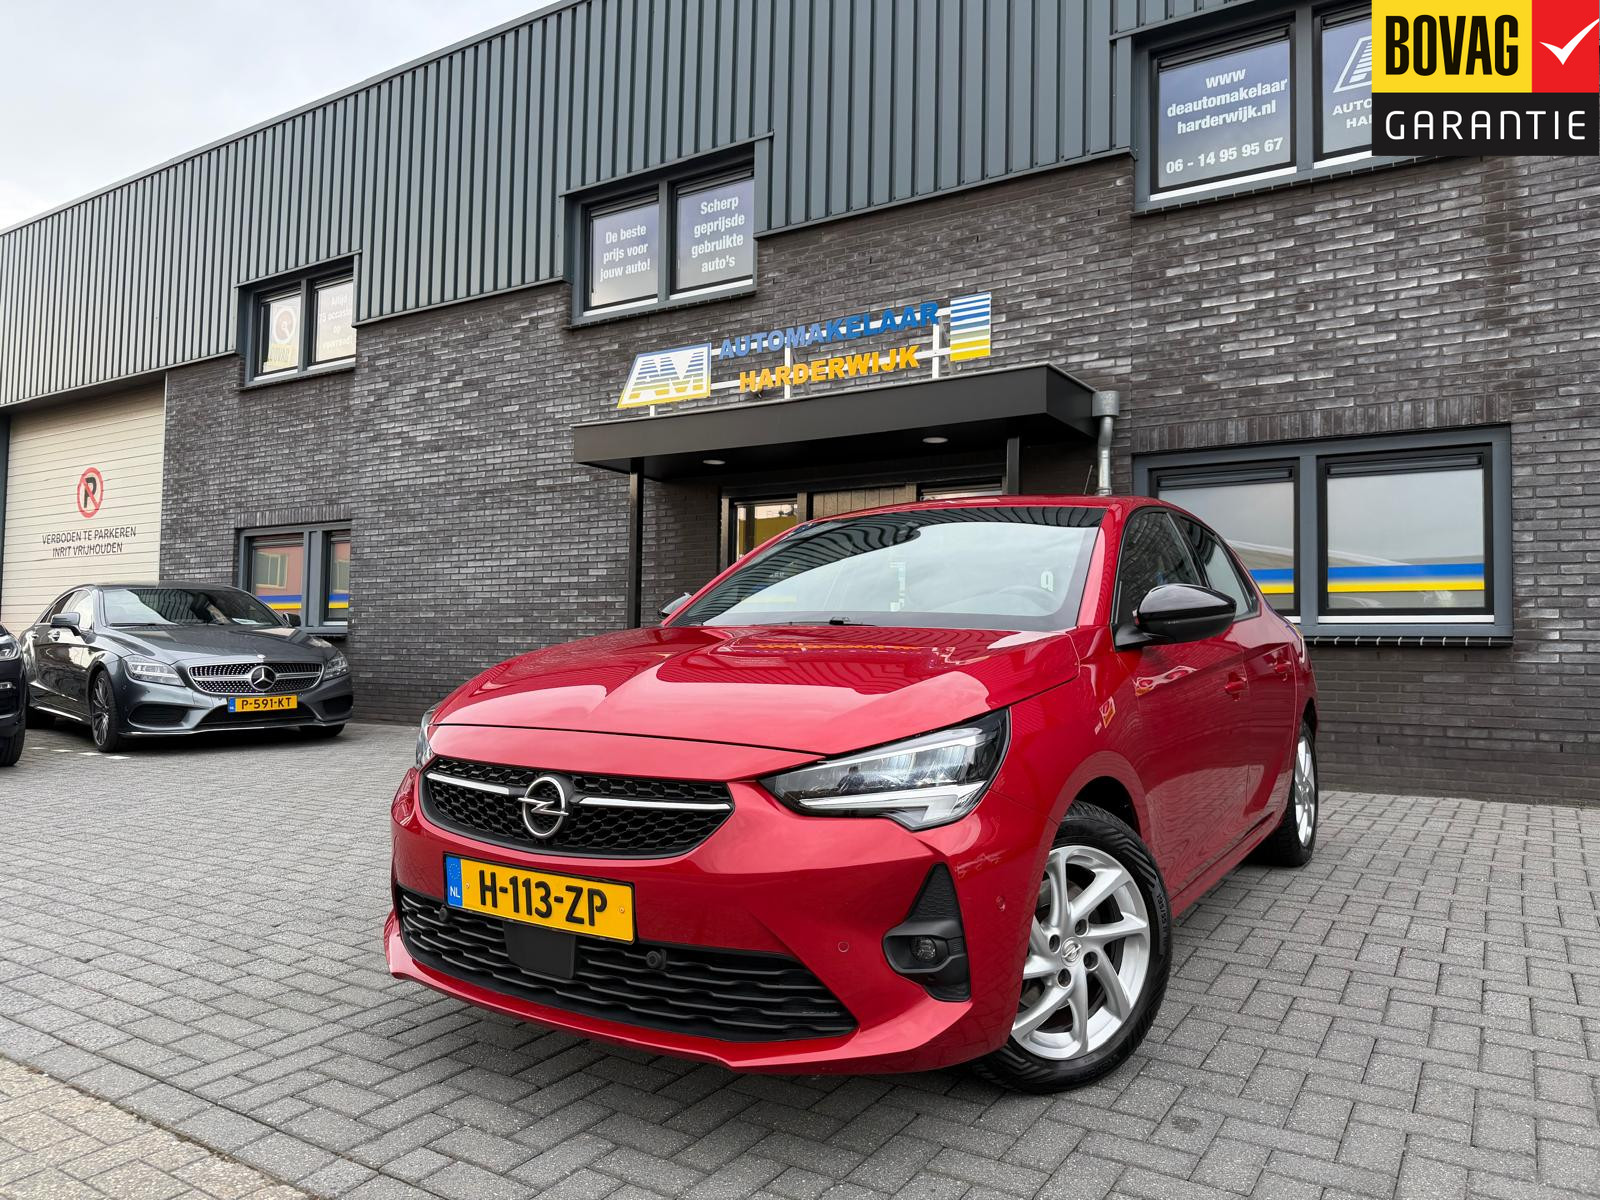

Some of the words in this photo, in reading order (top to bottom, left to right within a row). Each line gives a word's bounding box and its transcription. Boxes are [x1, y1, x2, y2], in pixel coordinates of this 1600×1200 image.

[1205, 69, 1246, 88] www
[1167, 79, 1288, 117] deautomakelaar
[1177, 100, 1277, 134] harderwijk.nl
[1346, 115, 1372, 129] HA
[1166, 158, 1183, 174] 06
[1198, 151, 1216, 167] 14
[1219, 147, 1238, 163] 95
[1241, 142, 1260, 157] 95
[1264, 137, 1284, 152] 67
[700, 196, 740, 215] Scherp
[605, 231, 618, 245] De
[620, 224, 647, 241] beste
[694, 213, 746, 238] geprijsde
[603, 246, 625, 264] prijs
[626, 243, 649, 257] voor
[691, 233, 744, 258] gebruikte
[599, 267, 624, 282] jouw
[625, 258, 651, 275] auto!
[701, 255, 736, 273] auto's
[718, 301, 940, 361] AUTOMAKELAAR
[739, 344, 921, 392] HARDERWIJK
[42, 531, 82, 545] VERBODEN
[83, 530, 93, 541] TE
[94, 526, 137, 540] PARKEREN
[52, 545, 72, 558] INRIT
[73, 542, 123, 556] VRIJHOUDEN
[241, 697, 292, 710] P-591-KT
[450, 886, 461, 898] NL
[479, 869, 608, 927] H-113-ZP
